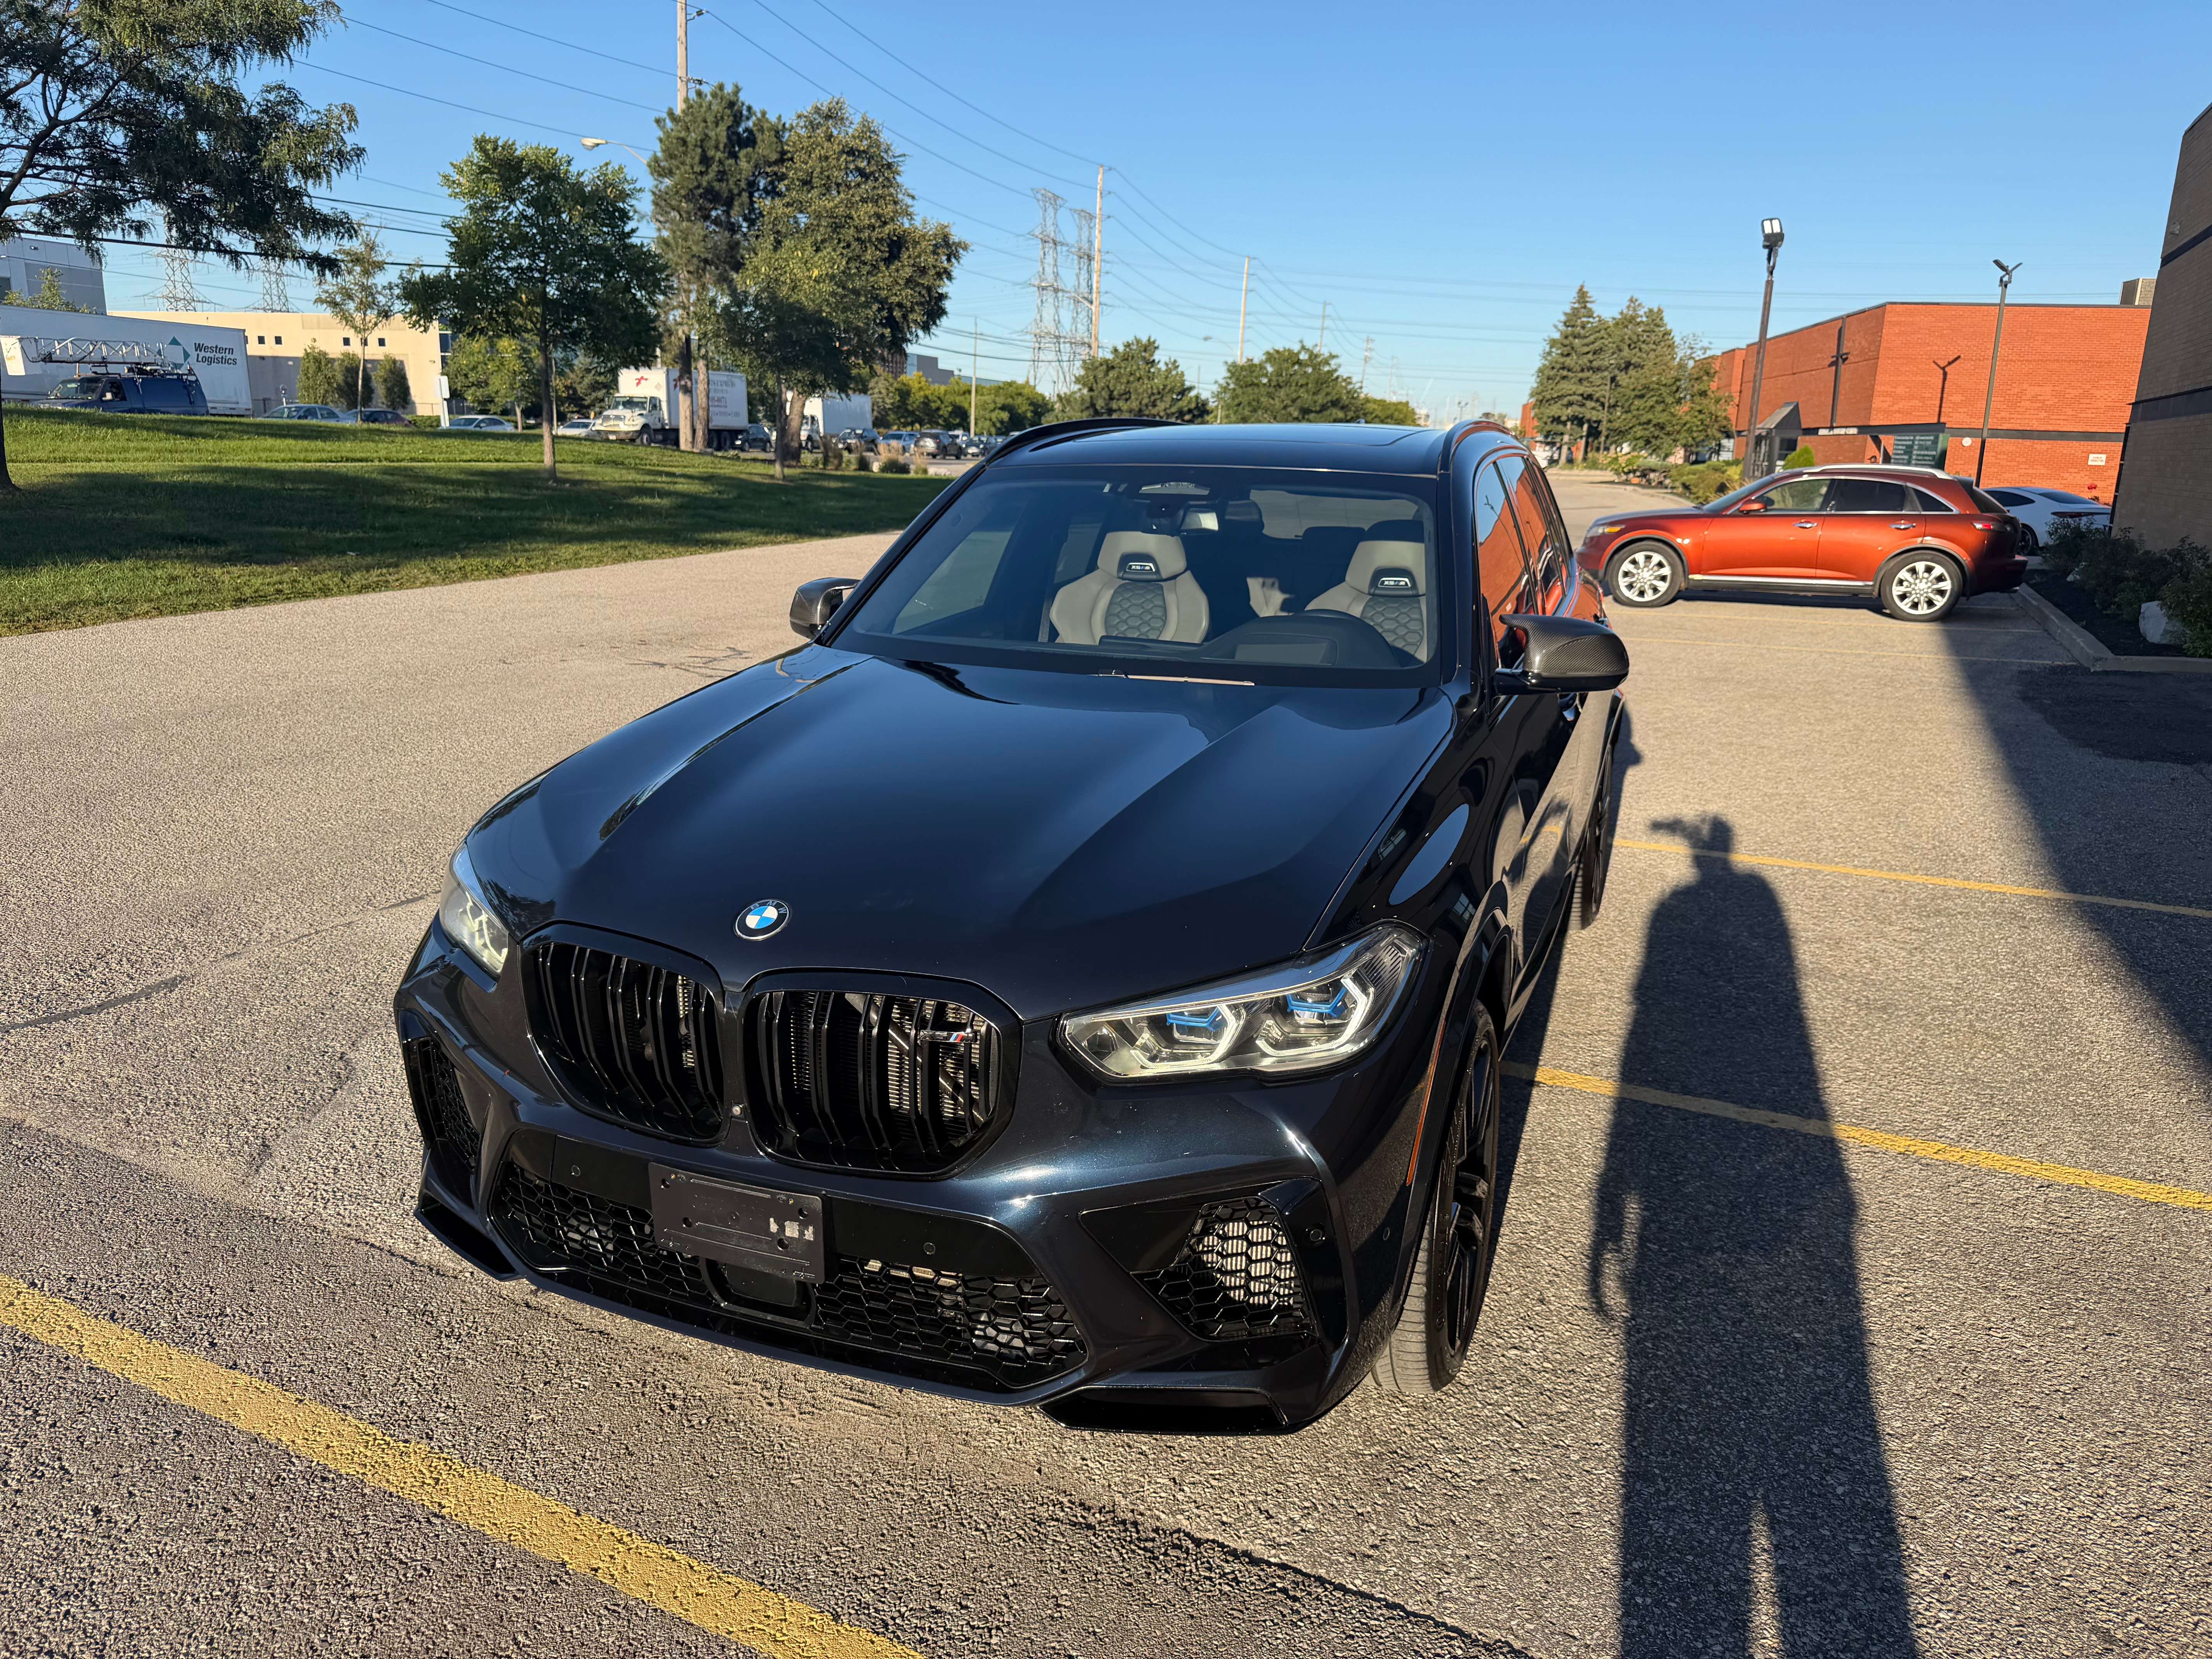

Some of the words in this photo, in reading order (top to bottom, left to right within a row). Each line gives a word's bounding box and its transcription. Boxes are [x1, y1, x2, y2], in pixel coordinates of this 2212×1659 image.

[194, 342, 234, 355] Western
[196, 353, 237, 366] Logistics
[750, 900, 788, 914] BMW
